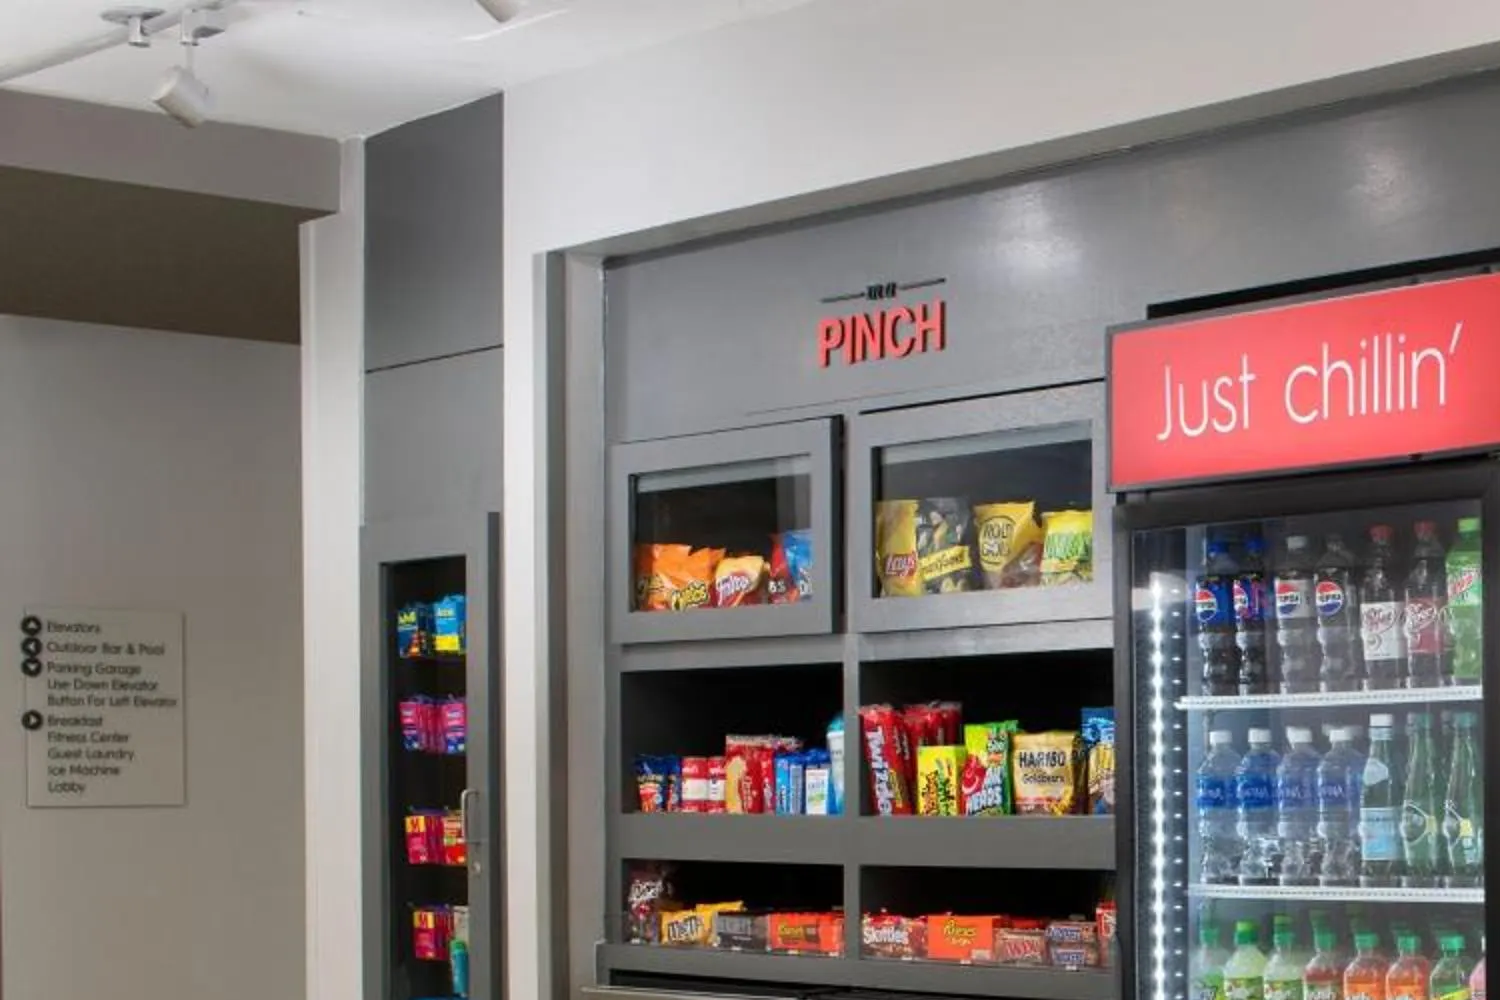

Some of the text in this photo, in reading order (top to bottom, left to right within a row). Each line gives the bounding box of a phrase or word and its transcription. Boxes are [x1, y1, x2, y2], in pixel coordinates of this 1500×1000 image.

[817, 301, 946, 369] PINCH
[1156, 321, 1464, 441] Just chillin'
[47, 662, 142, 677] Parking Garage
[47, 731, 130, 744] Fitness Center
[47, 748, 135, 762] Guest Laundry
[1019, 751, 1067, 770] HARIBO
[69, 764, 121, 776] Machine
[47, 781, 86, 794] Lobby
[862, 924, 910, 946] Skittles
